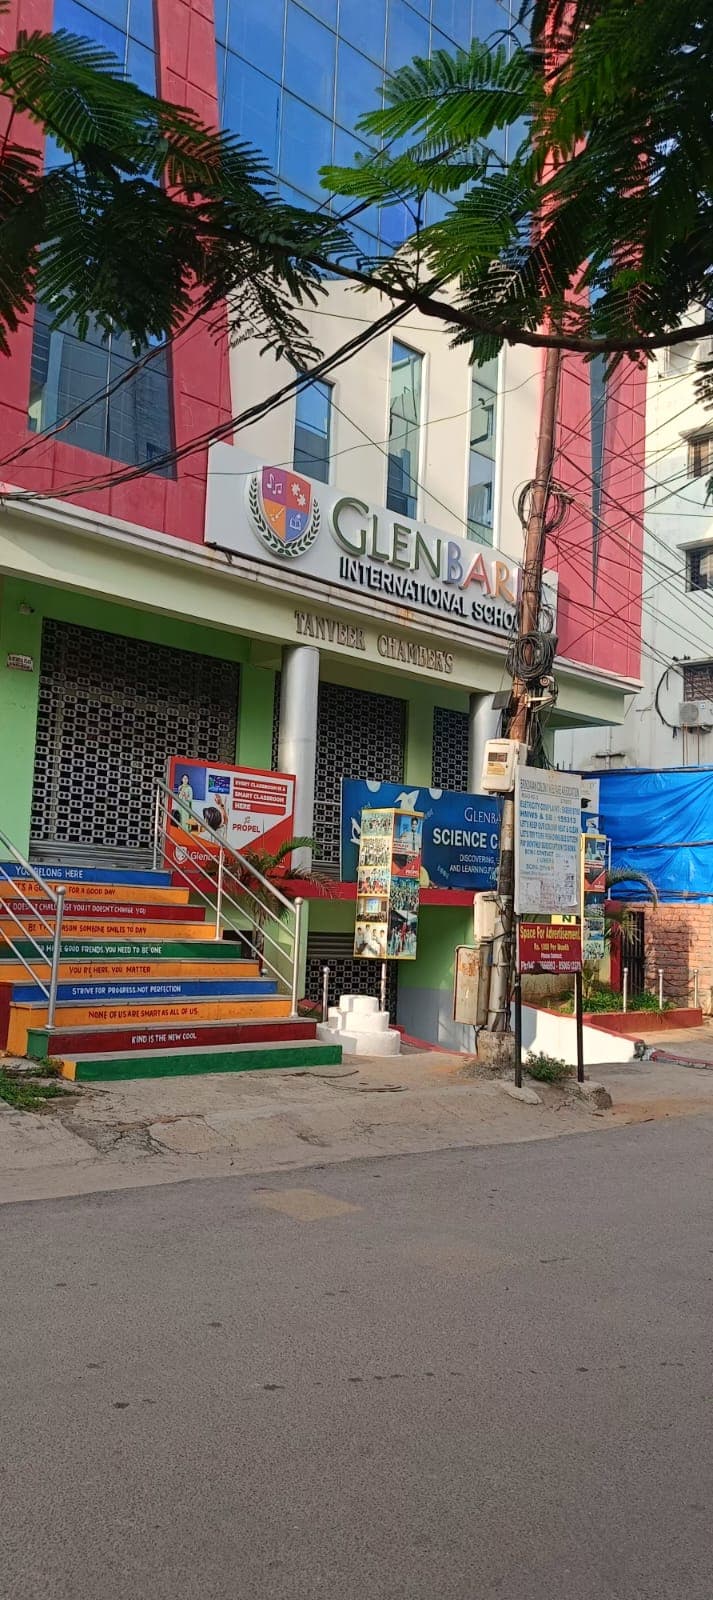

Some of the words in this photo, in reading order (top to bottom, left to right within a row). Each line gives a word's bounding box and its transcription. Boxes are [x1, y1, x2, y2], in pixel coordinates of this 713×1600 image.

[328, 496, 524, 606] GLENBAR
[338, 556, 469, 618] INTERNATIONAL
[472, 601, 520, 632] SCHO
[295, 611, 366, 651] TANVEER
[235, 791, 253, 799] SMART
[254, 793, 285, 802] CLASSROOM
[233, 823, 261, 833] PROPEL
[433, 828, 488, 849] SCIENCE
[65, 869, 84, 879] HERE
[450, 864, 461, 873] AND
[68, 887, 80, 895] FOR
[86, 888, 103, 896] GOOD
[73, 904, 84, 912] YOU
[136, 907, 147, 915] YOU
[28, 923, 36, 932] BE
[79, 925, 105, 933] SOMEONE
[106, 926, 126, 934] SMILES
[520, 926, 536, 942] Space
[537, 926, 546, 939] For
[64, 945, 79, 953] GOOD
[117, 946, 132, 954] NEED
[150, 946, 163, 954] ONE
[69, 966, 82, 974] YOU
[126, 966, 151, 974] MATTER
[72, 987, 94, 996] STRIVE
[95, 987, 106, 995] FOR
[137, 986, 149, 994] NOT
[149, 985, 181, 994] PERFECTION
[88, 1011, 107, 1020] NONE
[109, 1010, 117, 1019] OF
[118, 1010, 127, 1018] US
[127, 1010, 140, 1018] ARE
[140, 1009, 161, 1018] SMART
[169, 1008, 180, 1016] ALL
[181, 1007, 189, 1015] OF
[131, 1035, 147, 1044] KIND
[148, 1035, 155, 1043] IS
[155, 1034, 167, 1043] THE
[167, 1034, 182, 1042] NEW
[182, 1033, 198, 1041] COOL
